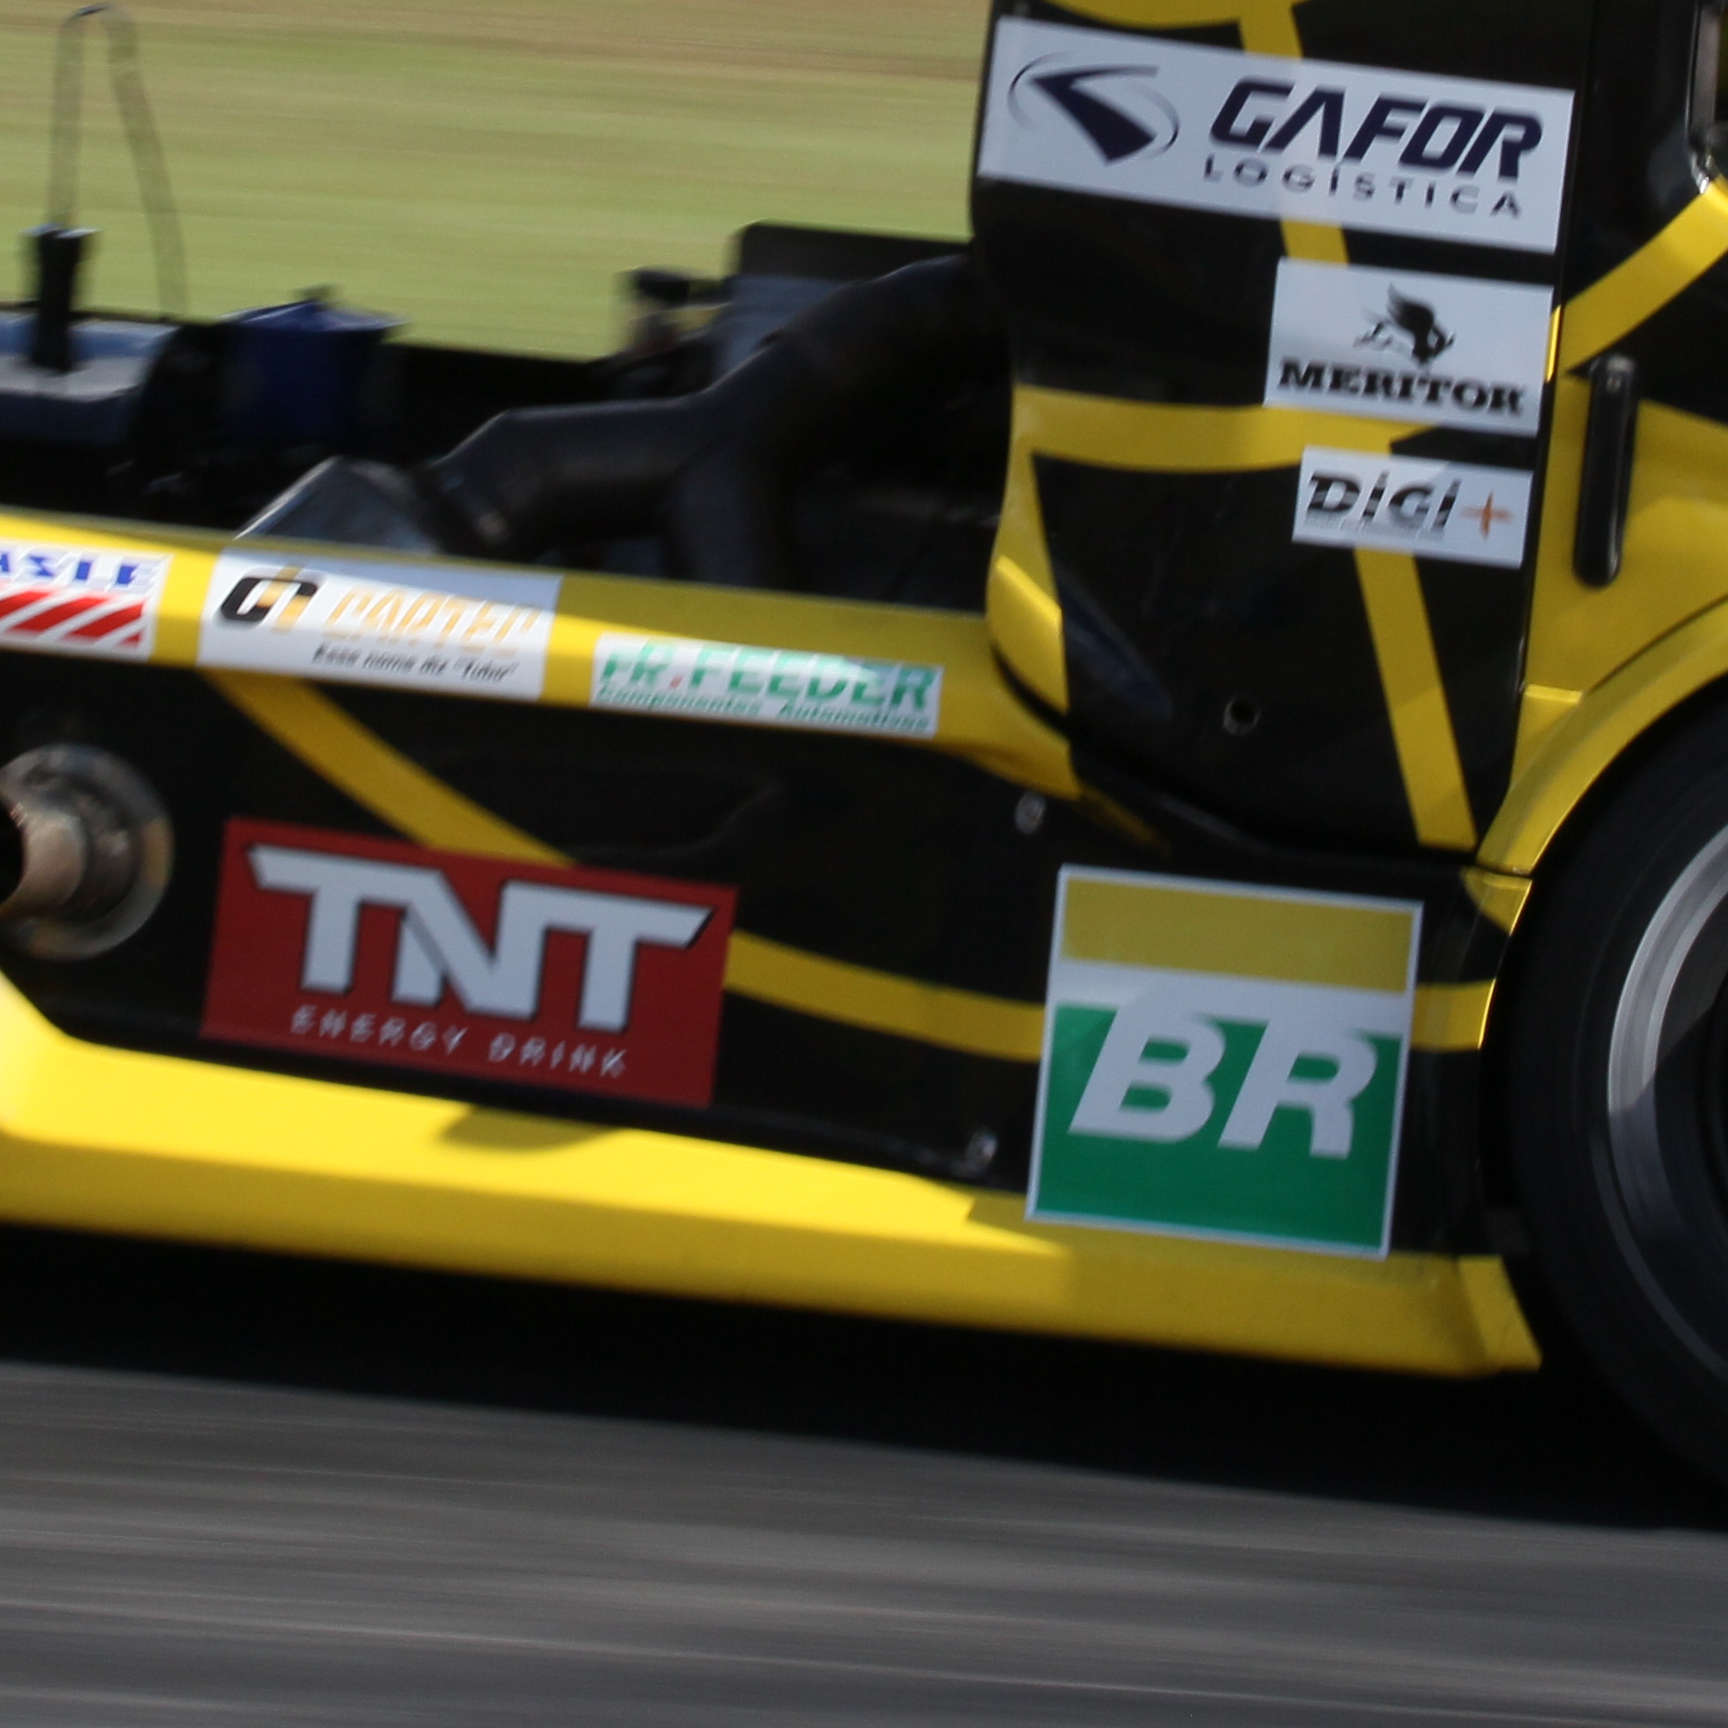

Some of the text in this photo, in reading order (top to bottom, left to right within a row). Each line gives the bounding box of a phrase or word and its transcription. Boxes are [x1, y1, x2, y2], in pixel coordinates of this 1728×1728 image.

[1209, 77, 1542, 182] GAFOR
[1278, 360, 1525, 417] MERITOR
[247, 842, 714, 1035] TNT
[288, 1004, 628, 1079] ENERGY DRINK
[1069, 987, 1380, 1159] BR
